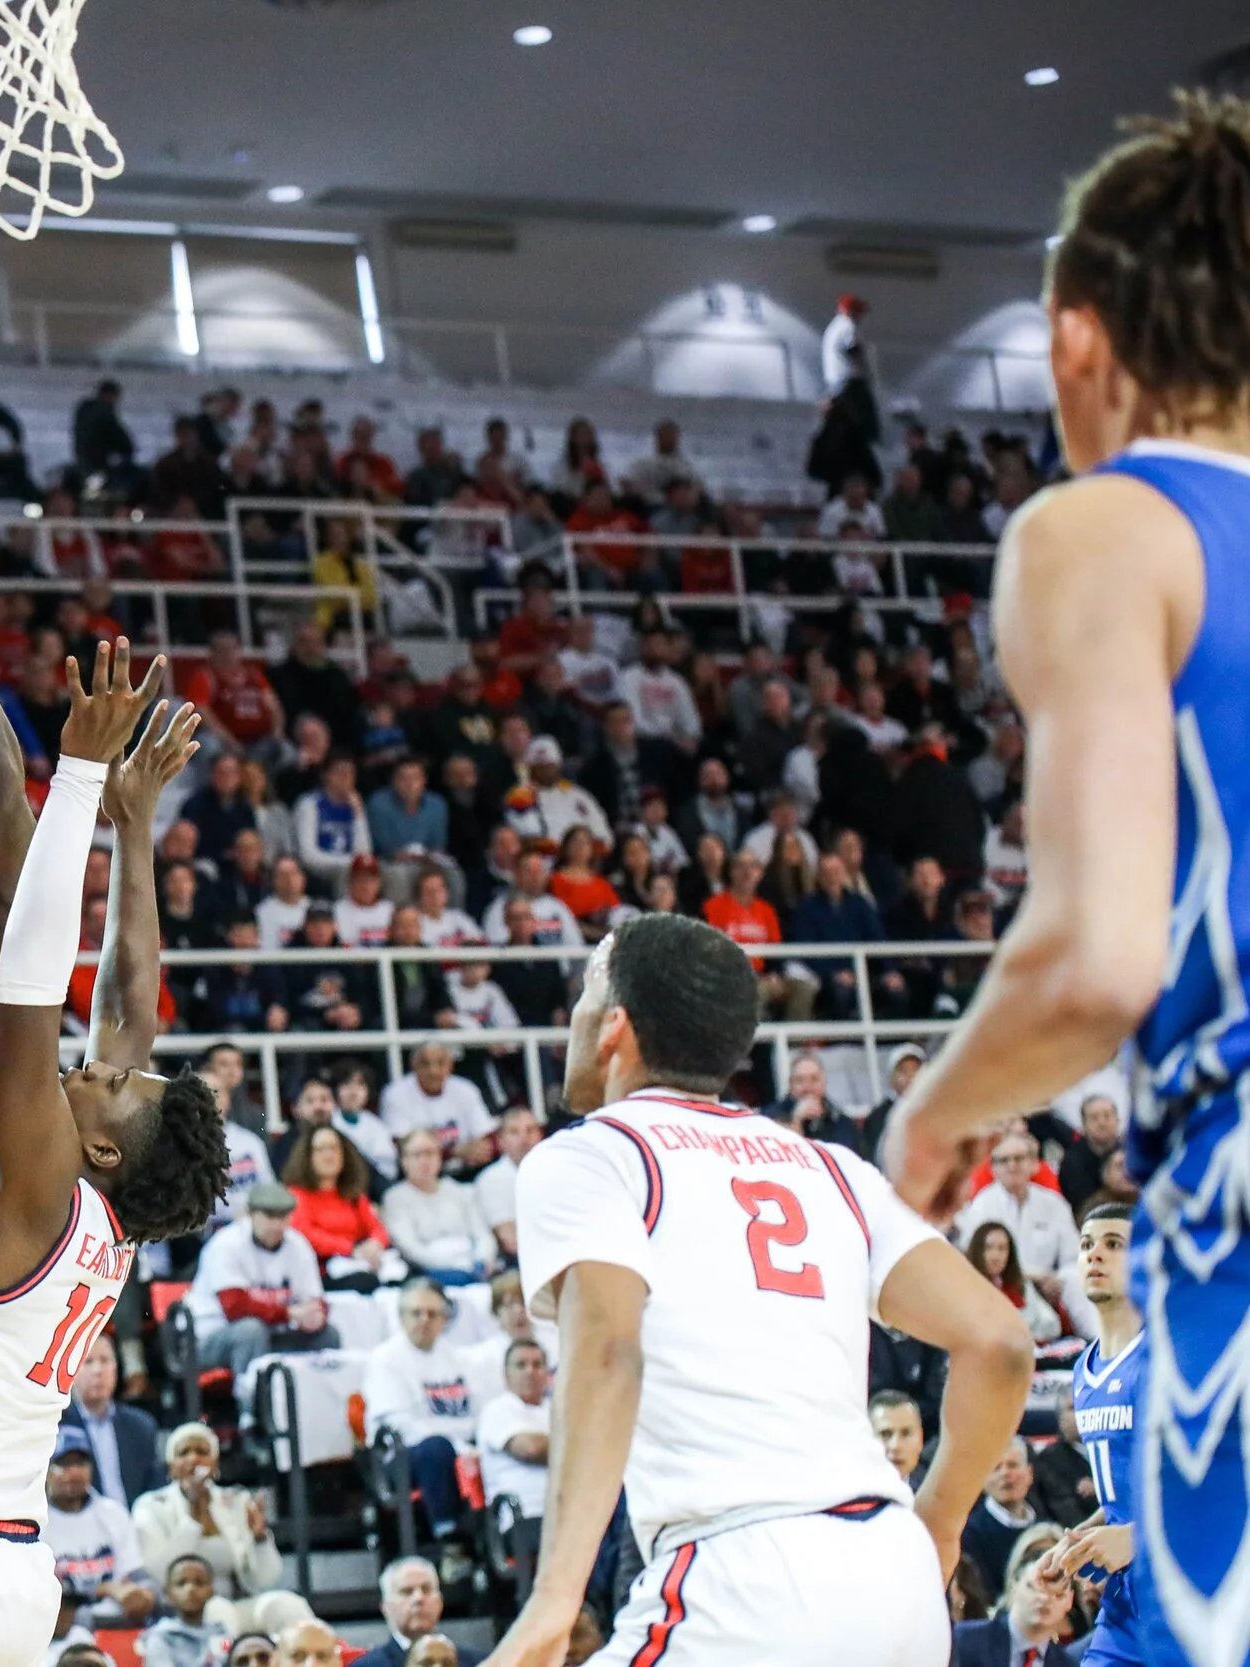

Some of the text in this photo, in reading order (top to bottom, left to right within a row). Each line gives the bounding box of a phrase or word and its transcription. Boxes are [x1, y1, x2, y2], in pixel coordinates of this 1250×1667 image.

[649, 1124, 820, 1172] CHAMPAGNE
[731, 1176, 825, 1300] 2
[26, 1282, 117, 1395] 10
[1086, 1439, 1116, 1505] 11
